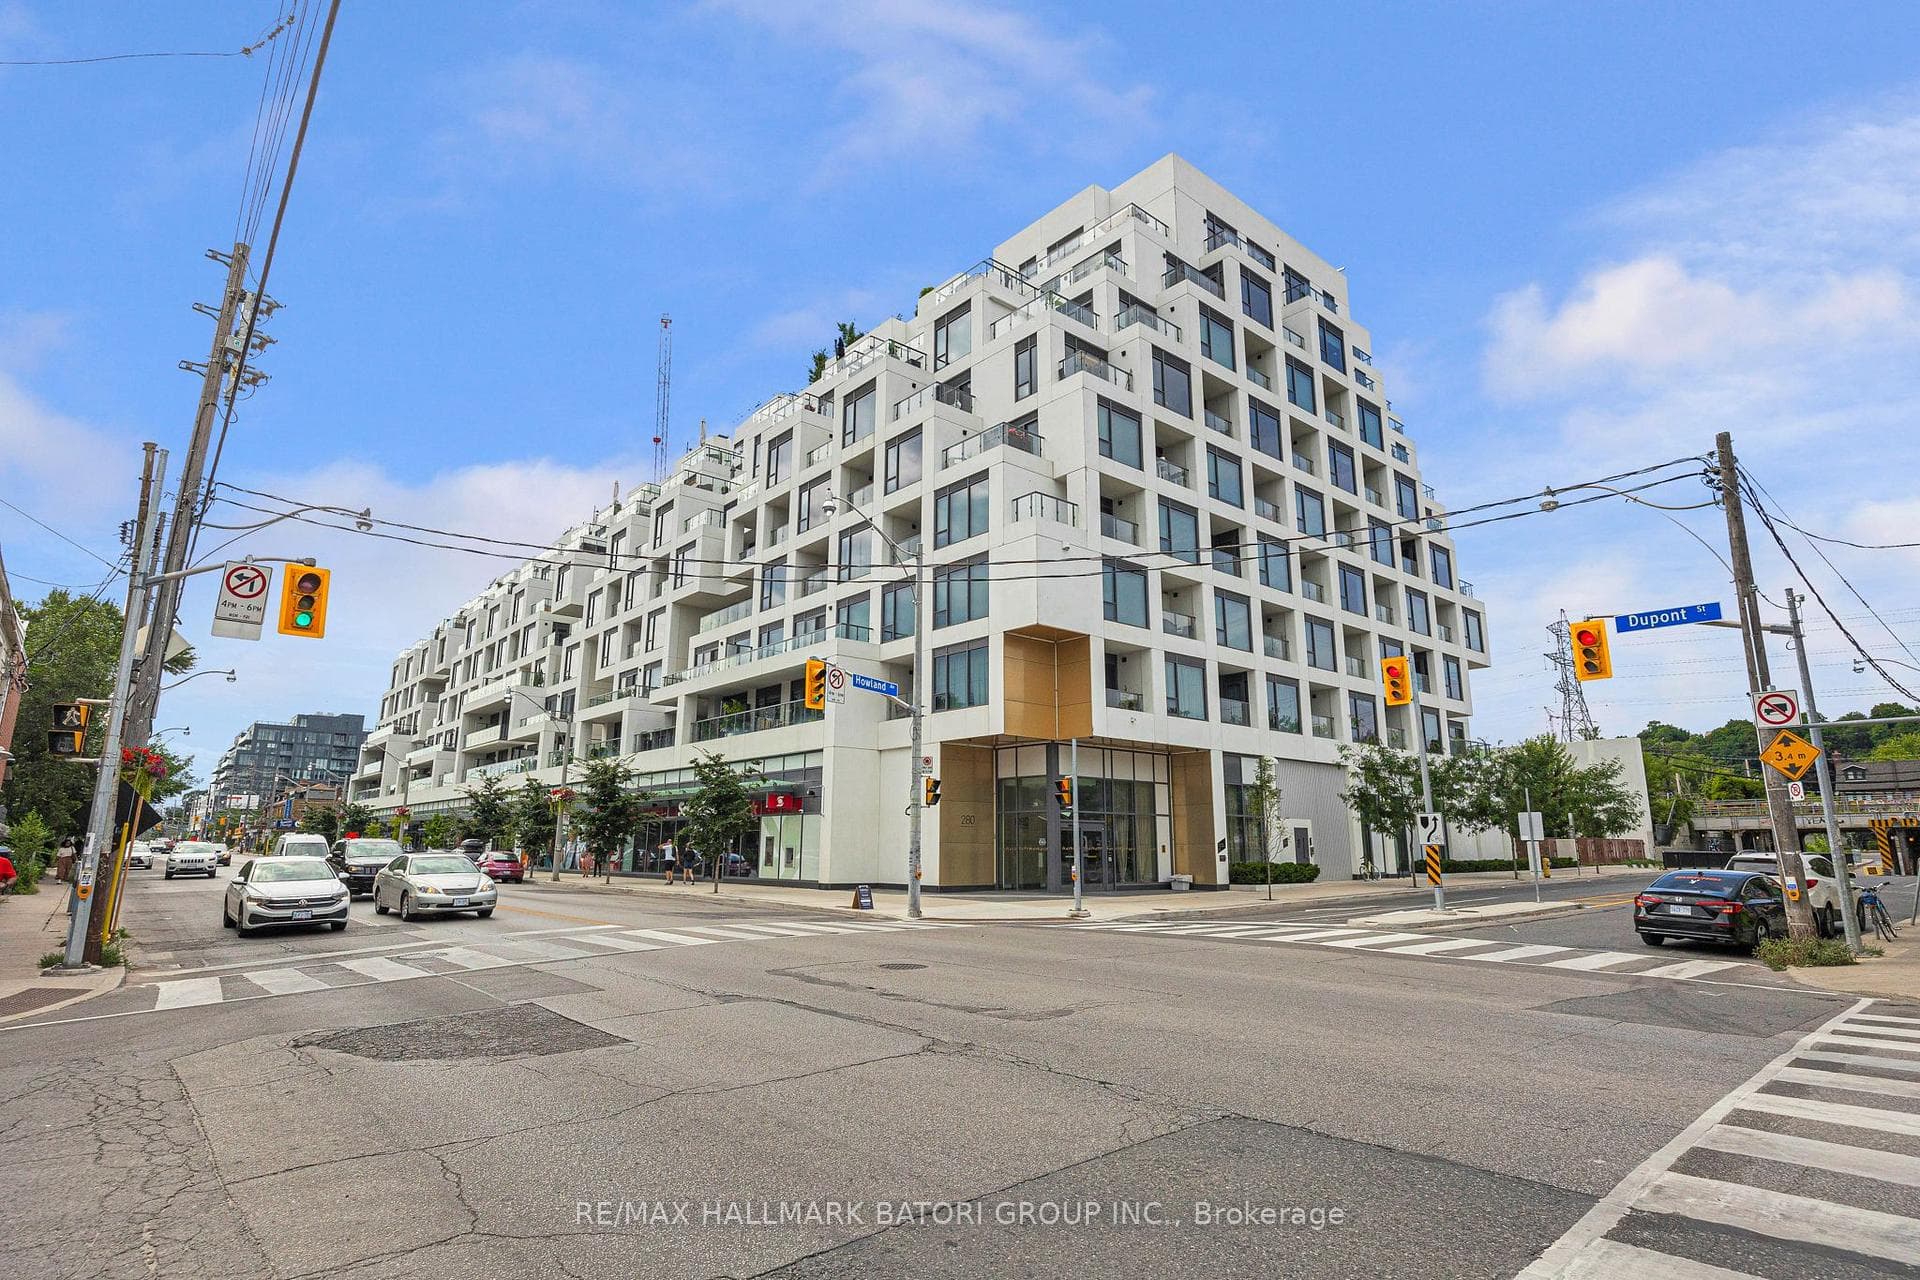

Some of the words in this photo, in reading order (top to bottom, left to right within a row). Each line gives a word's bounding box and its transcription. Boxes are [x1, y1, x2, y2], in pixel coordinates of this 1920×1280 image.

[220, 600, 238, 609] 4PM
[246, 603, 262, 612] 6PM
[1628, 608, 1688, 627] Dupont
[1696, 605, 1706, 613] St
[855, 674, 887, 691] Howland
[1774, 751, 1794, 762] 3.4
[960, 814, 976, 825] 280
